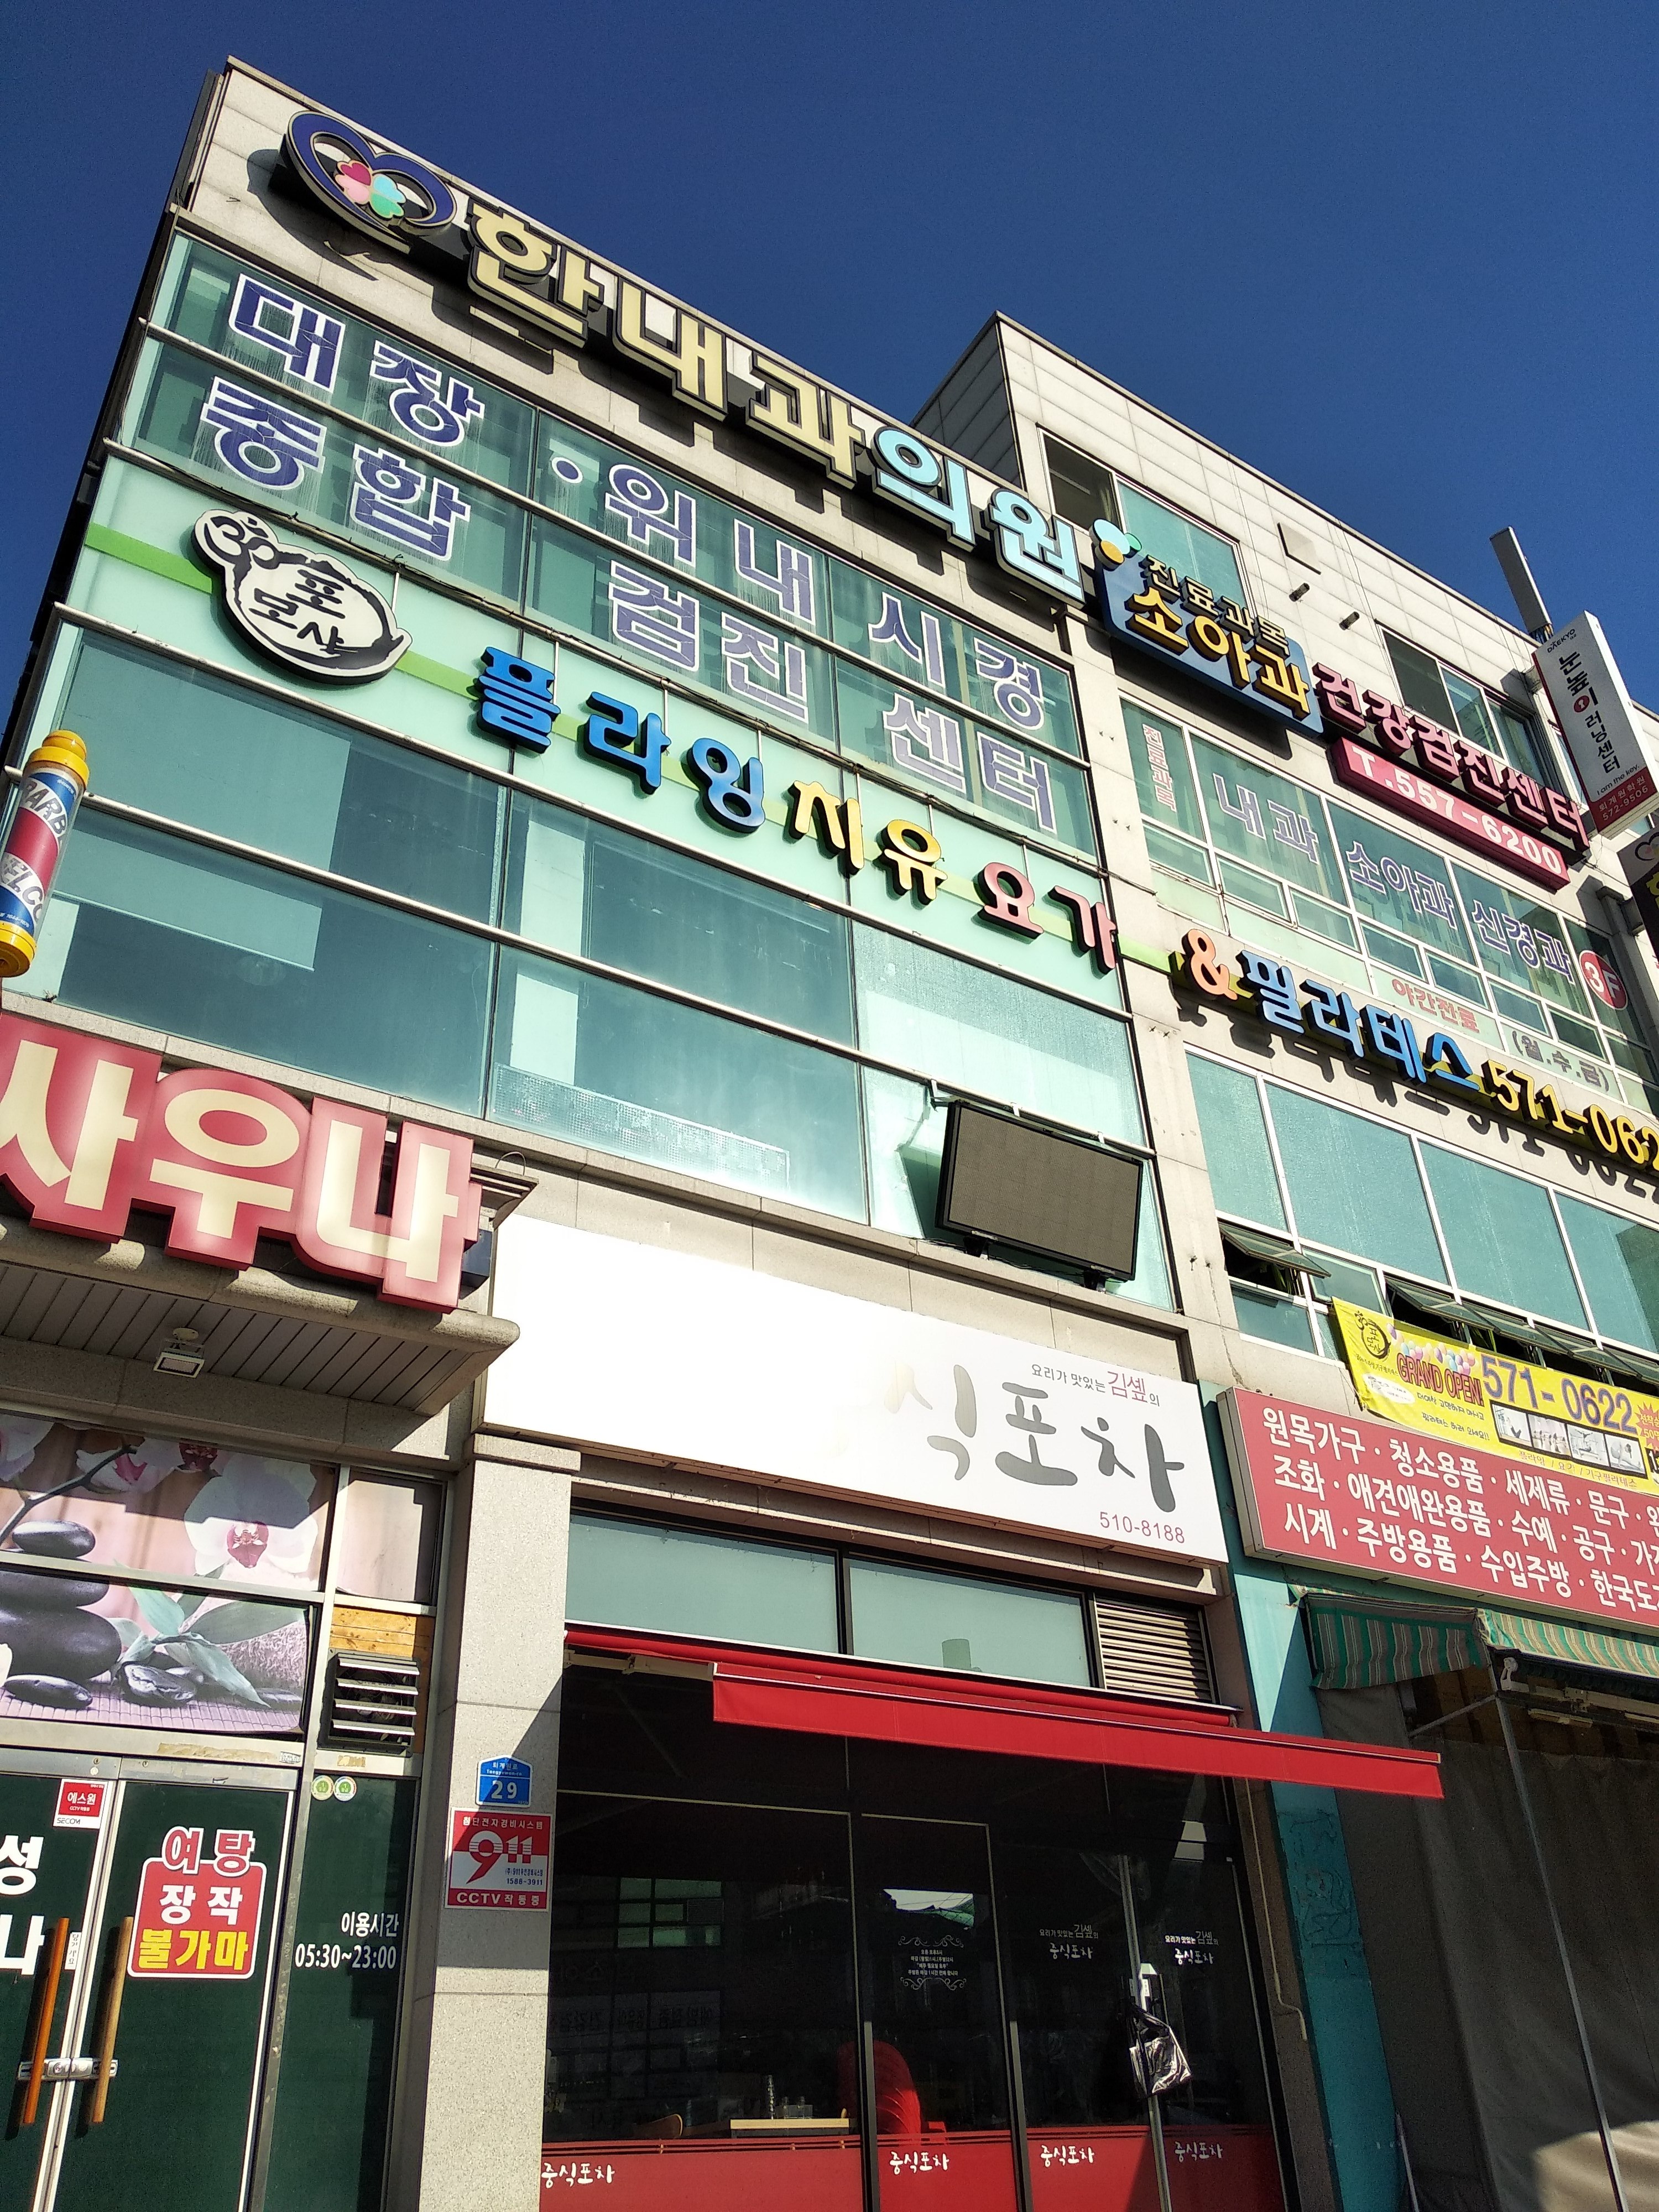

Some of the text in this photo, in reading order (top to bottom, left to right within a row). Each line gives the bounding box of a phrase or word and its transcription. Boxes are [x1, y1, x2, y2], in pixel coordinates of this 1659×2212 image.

[467, 197, 1086, 608] 한내과의원
[1141, 554, 1290, 659] 진료과목
[1126, 587, 1312, 722] 소아과
[1547, 628, 1576, 654] DAEKYO
[1312, 662, 1590, 852] 건강검진센터
[1584, 709, 1621, 774] 러닝센터
[1600, 782, 1613, 793] am
[1603, 785, 1648, 821] 572-9506
[476, 646, 765, 832] 플라잉
[977, 862, 1118, 974] 요가
[1182, 927, 1238, 1002] &
[1237, 949, 1481, 1092] 필라테스
[1212, 771, 1577, 985] 내과 소아과 신경과
[0, 1039, 460, 1284] 사우나
[1031, 1363, 1067, 1384] 요리가
[1071, 1373, 1106, 1394] 맛있는
[1396, 1352, 1444, 1394] GRAND
[1444, 1368, 1485, 1407] OPEN!
[1262, 1407, 1366, 1465] 원목가구
[1390, 1438, 1484, 1494] 청소용품
[1505, 1469, 1571, 1516] 세제류
[1588, 1489, 1630, 1530] 문구
[1099, 1510, 1186, 1545] 510-8188
[1273, 1454, 1326, 1501] 조화
[1348, 1472, 1492, 1538] 애견애완용품
[1511, 1509, 1558, 1553] 수예
[1572, 1524, 1616, 1566] 공구
[1284, 1503, 1337, 1551] 시계
[1357, 1516, 1457, 1574] 주방용품
[1479, 1544, 1573, 1599] 수입주방
[67, 1792, 97, 1806] 에스원
[491, 1780, 518, 1800] 29
[163, 1825, 256, 1877] 여탕
[466, 1830, 533, 1884] 911
[456, 1892, 540, 1906] CCTV 작동중
[506, 1877, 543, 1886] 1588-3911
[159, 1885, 243, 1926] 장작
[341, 1911, 399, 1937] 이용시간
[1039, 1928, 1056, 1937] 요리가
[1057, 1929, 1074, 1938] 맛있는
[1165, 1935, 1181, 1944] 요리가
[1181, 1935, 1196, 1945] 맛있는
[138, 1928, 249, 1971] 불가마
[295, 1943, 397, 1969] 05:30~23:00
[1050, 1942, 1094, 1960] 중식포차
[1175, 1948, 1214, 1965] 중식포차
[889, 2151, 950, 2175] 중식포차
[1040, 2145, 1095, 2167] 중식포차
[1175, 2141, 1224, 2162] 중식포차
[540, 2162, 615, 2188] 중식포차
